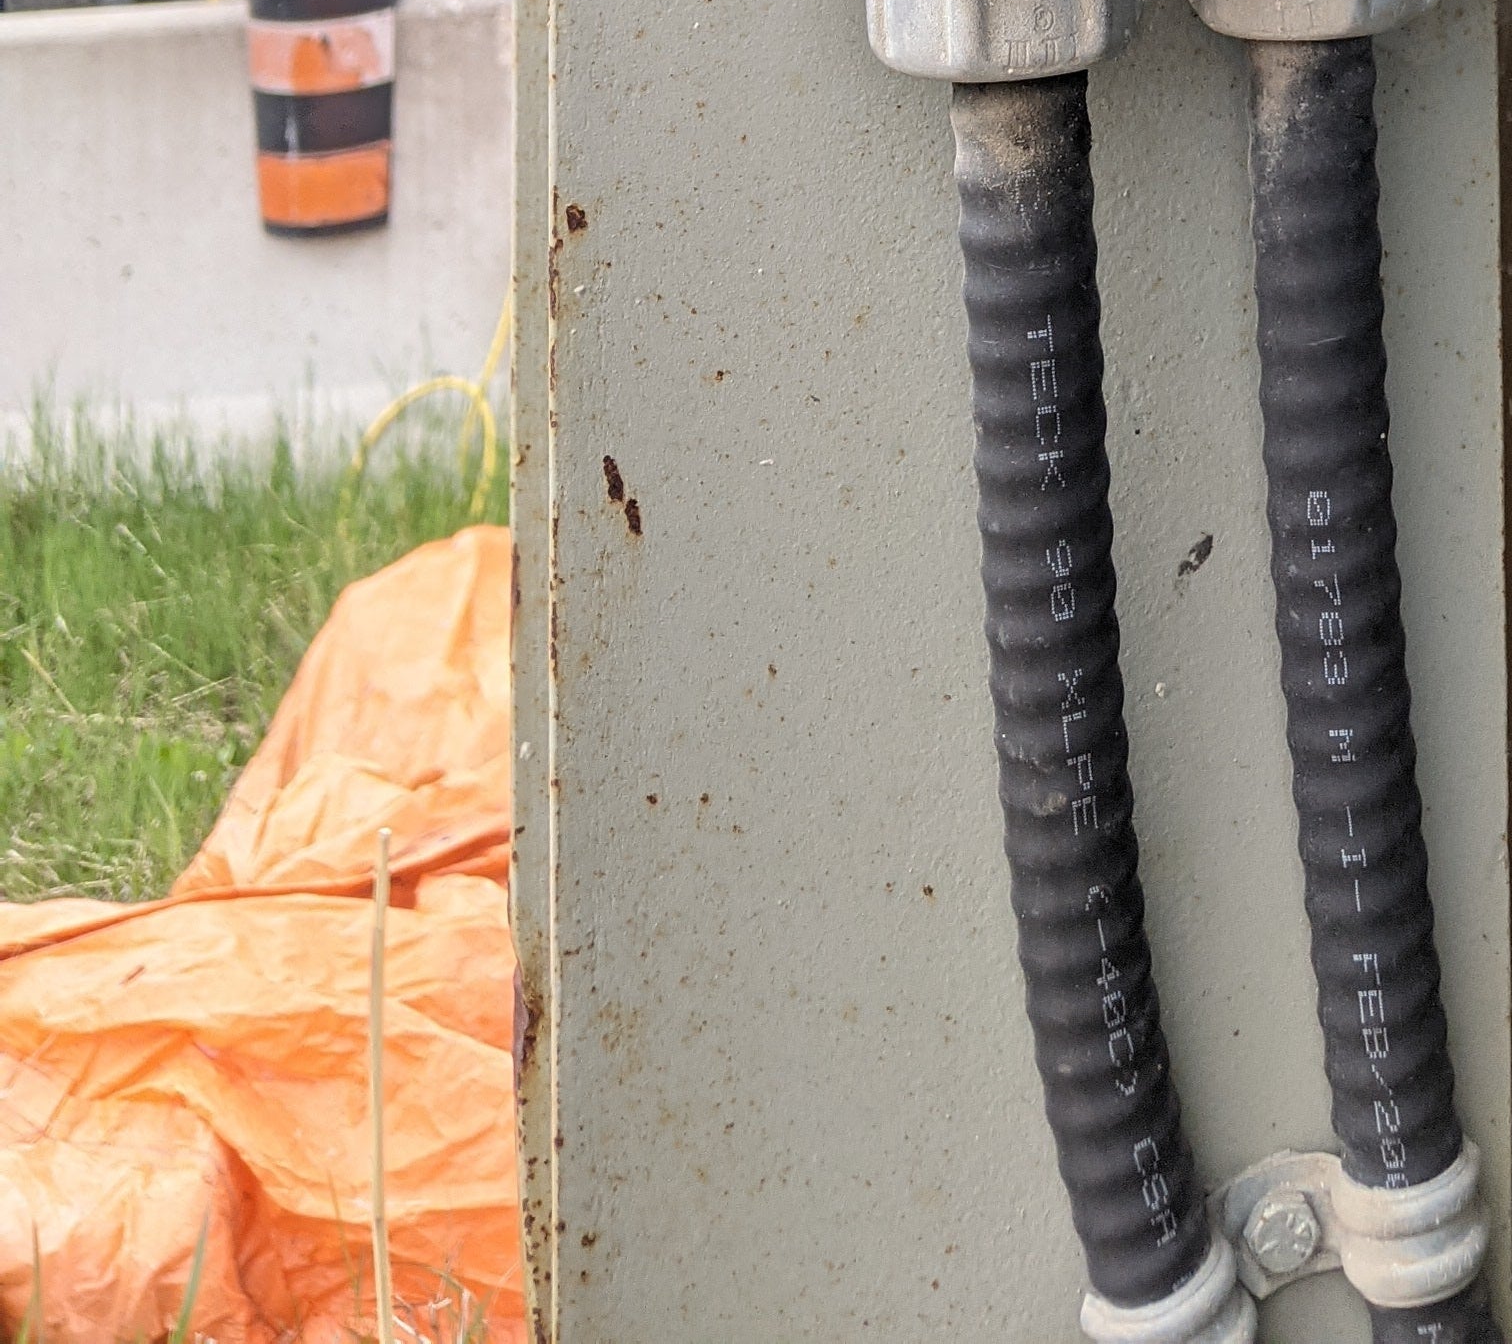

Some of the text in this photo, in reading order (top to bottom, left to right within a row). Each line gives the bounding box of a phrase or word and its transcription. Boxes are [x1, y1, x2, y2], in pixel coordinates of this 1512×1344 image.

[1026, 314, 1066, 492] TECK
[1045, 538, 1076, 623] 90
[1057, 668, 1099, 836] XLPE
[1132, 1135, 1178, 1248] CSA
